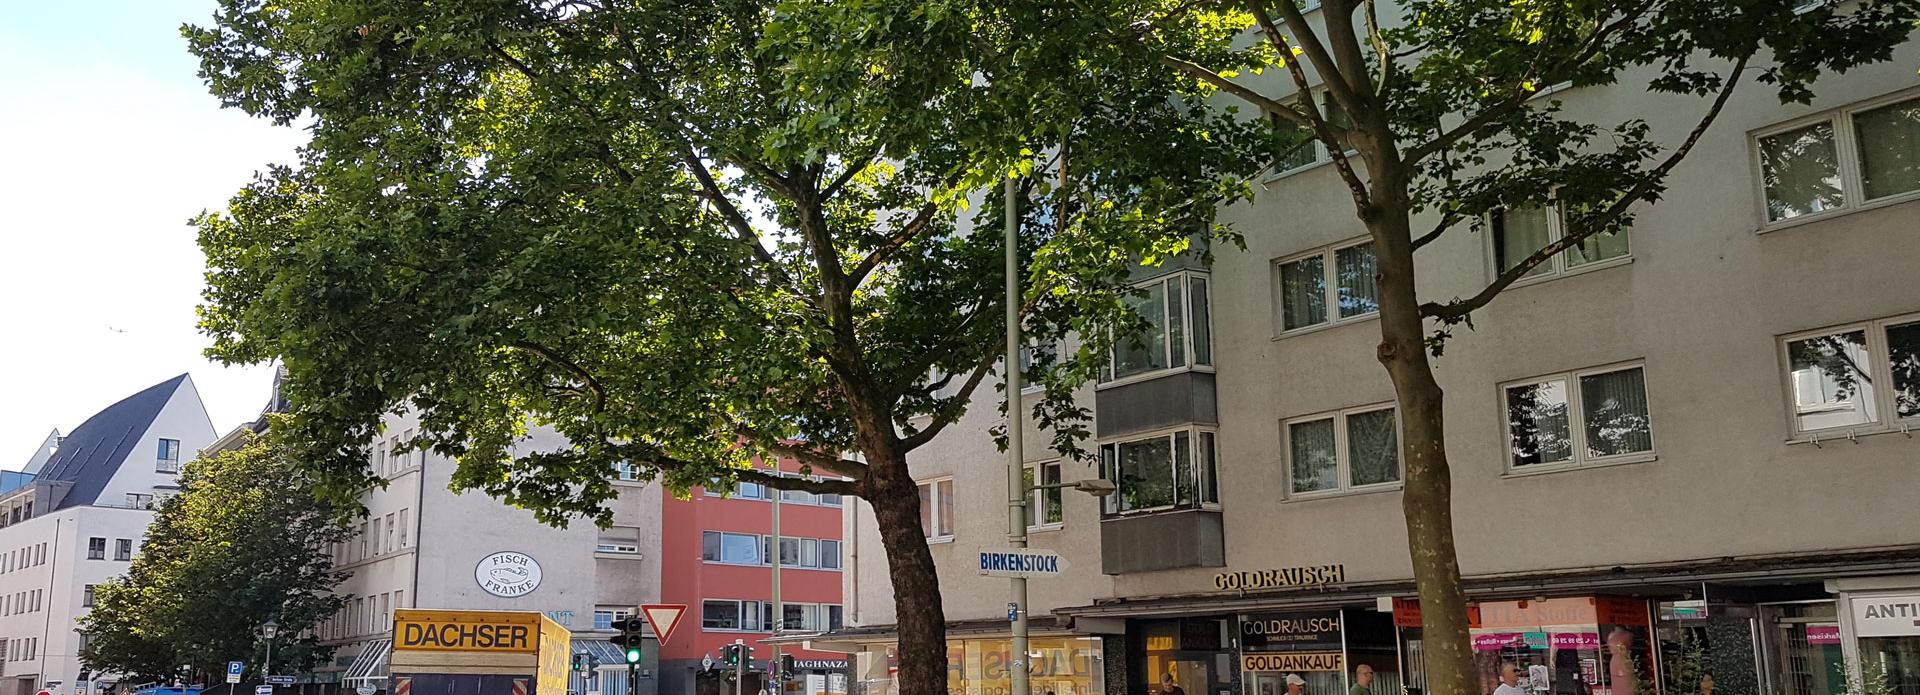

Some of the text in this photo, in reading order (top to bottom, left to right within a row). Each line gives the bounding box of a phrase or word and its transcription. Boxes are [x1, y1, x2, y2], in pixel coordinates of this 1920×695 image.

[492, 554, 528, 566] FISCH
[980, 552, 1058, 572] BIRKENSTOCK
[1214, 564, 1345, 590] GOLDRAUSCH
[485, 580, 534, 594] FRANKE
[1864, 602, 1920, 619] ANTI
[1243, 617, 1340, 635] GOLDRAUSCH
[404, 623, 528, 648] DACHSER
[230, 663, 240, 673] P
[1245, 654, 1342, 671] GOLDANKAUF
